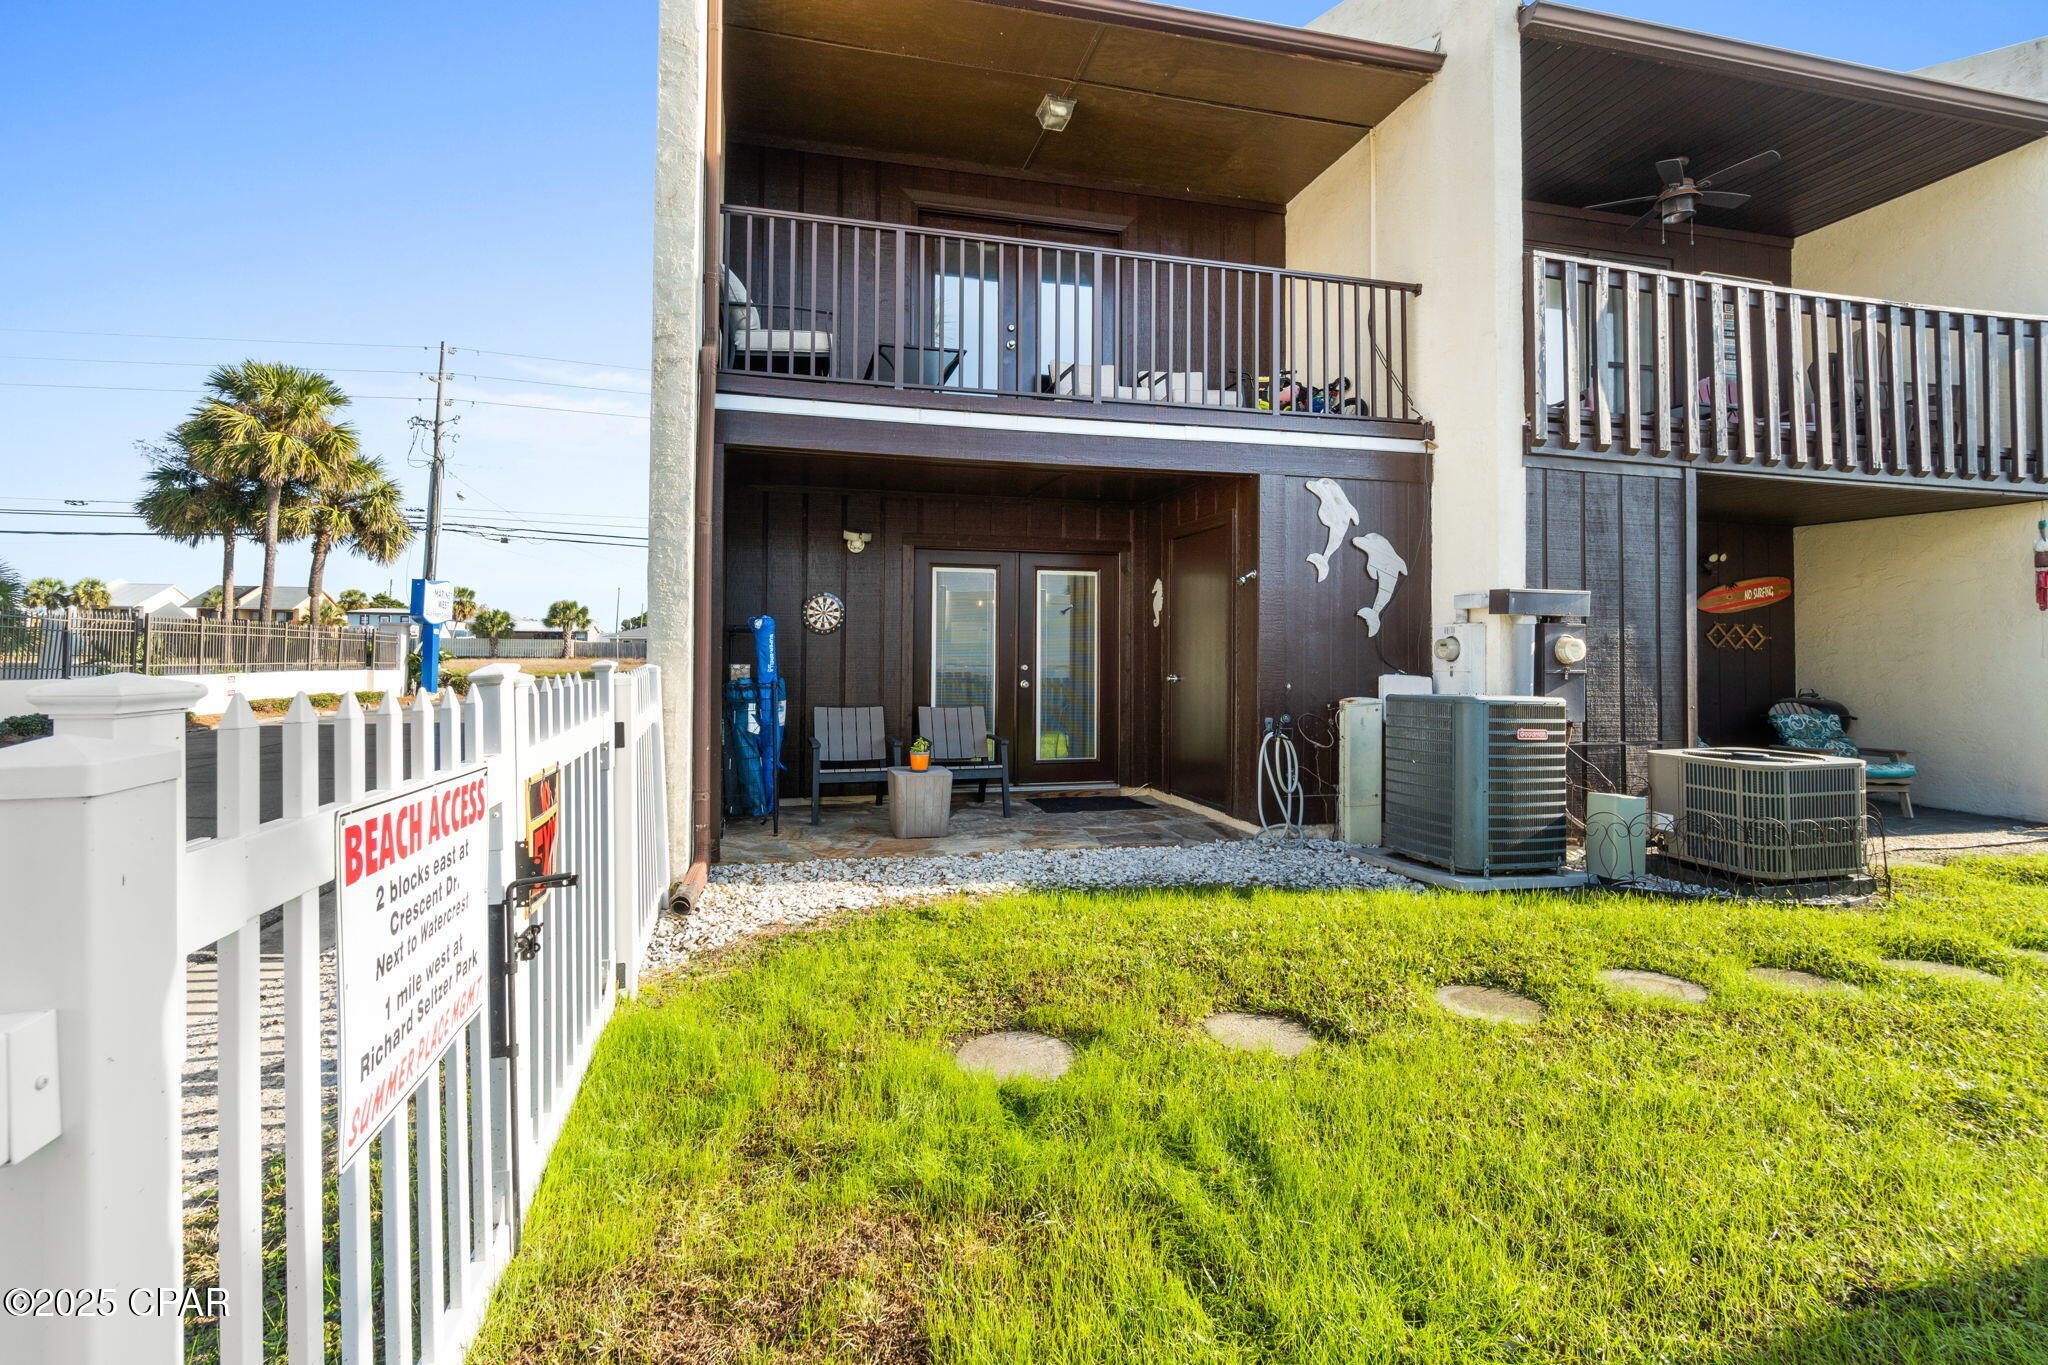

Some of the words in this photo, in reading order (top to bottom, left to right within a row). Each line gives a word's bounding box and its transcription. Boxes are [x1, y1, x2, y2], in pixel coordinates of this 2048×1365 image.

[1744, 589, 1752, 601] NO
[1753, 585, 1774, 599] SURFING
[345, 801, 422, 887] BEACH
[428, 778, 485, 845] ACCESS
[376, 885, 384, 912] 2
[390, 865, 430, 903] blocks
[433, 846, 456, 875] east
[459, 839, 469, 863] at
[376, 941, 404, 981] Next
[407, 935, 417, 956] to
[421, 891, 469, 944] Watercrest
[390, 882, 442, 935] Crescent
[446, 875, 460, 897] Dr.
[360, 1009, 413, 1083] Richard
[417, 975, 452, 1022] Seltzer
[456, 949, 478, 982] Park
[385, 996, 391, 1020] 1
[397, 974, 422, 1011] mile
[426, 944, 450, 982] west
[453, 933, 463, 957] at
[348, 1048, 414, 1147] SUMMER
[417, 1008, 450, 1070] PLACE
[451, 975, 482, 1028] MGMT
